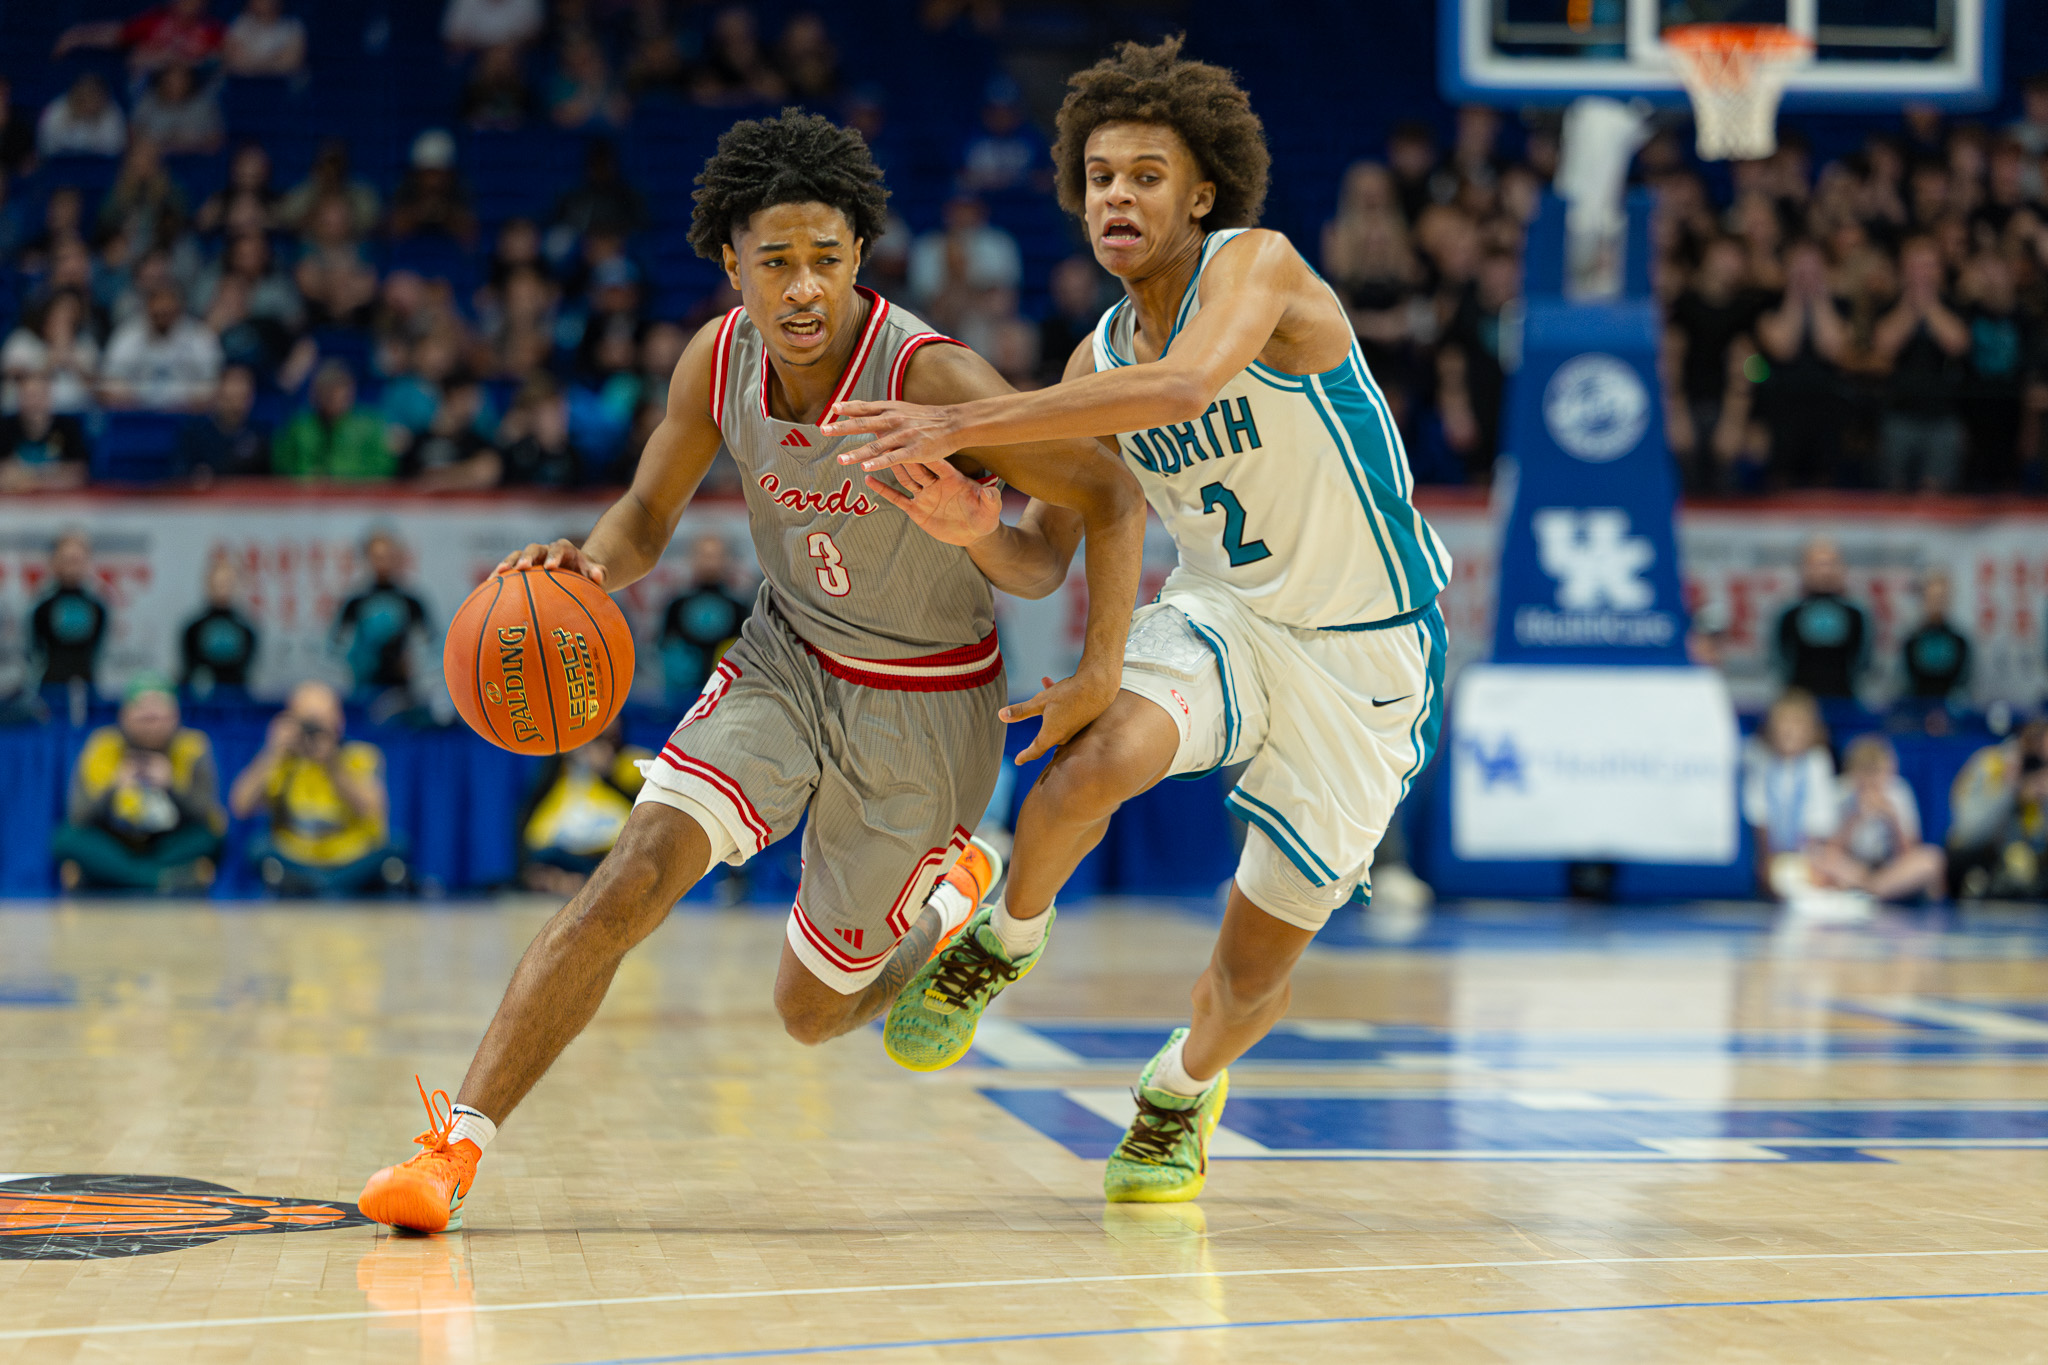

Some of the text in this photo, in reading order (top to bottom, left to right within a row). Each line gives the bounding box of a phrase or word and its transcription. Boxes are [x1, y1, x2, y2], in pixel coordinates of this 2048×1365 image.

[758, 472, 879, 517] Cards
[1200, 481, 1272, 567] 2
[807, 532, 851, 597] 3
[1531, 506, 1655, 612] UK
[497, 625, 545, 743] SPALDING
[551, 627, 587, 732] LEGACY
[575, 633, 597, 699] 1000
